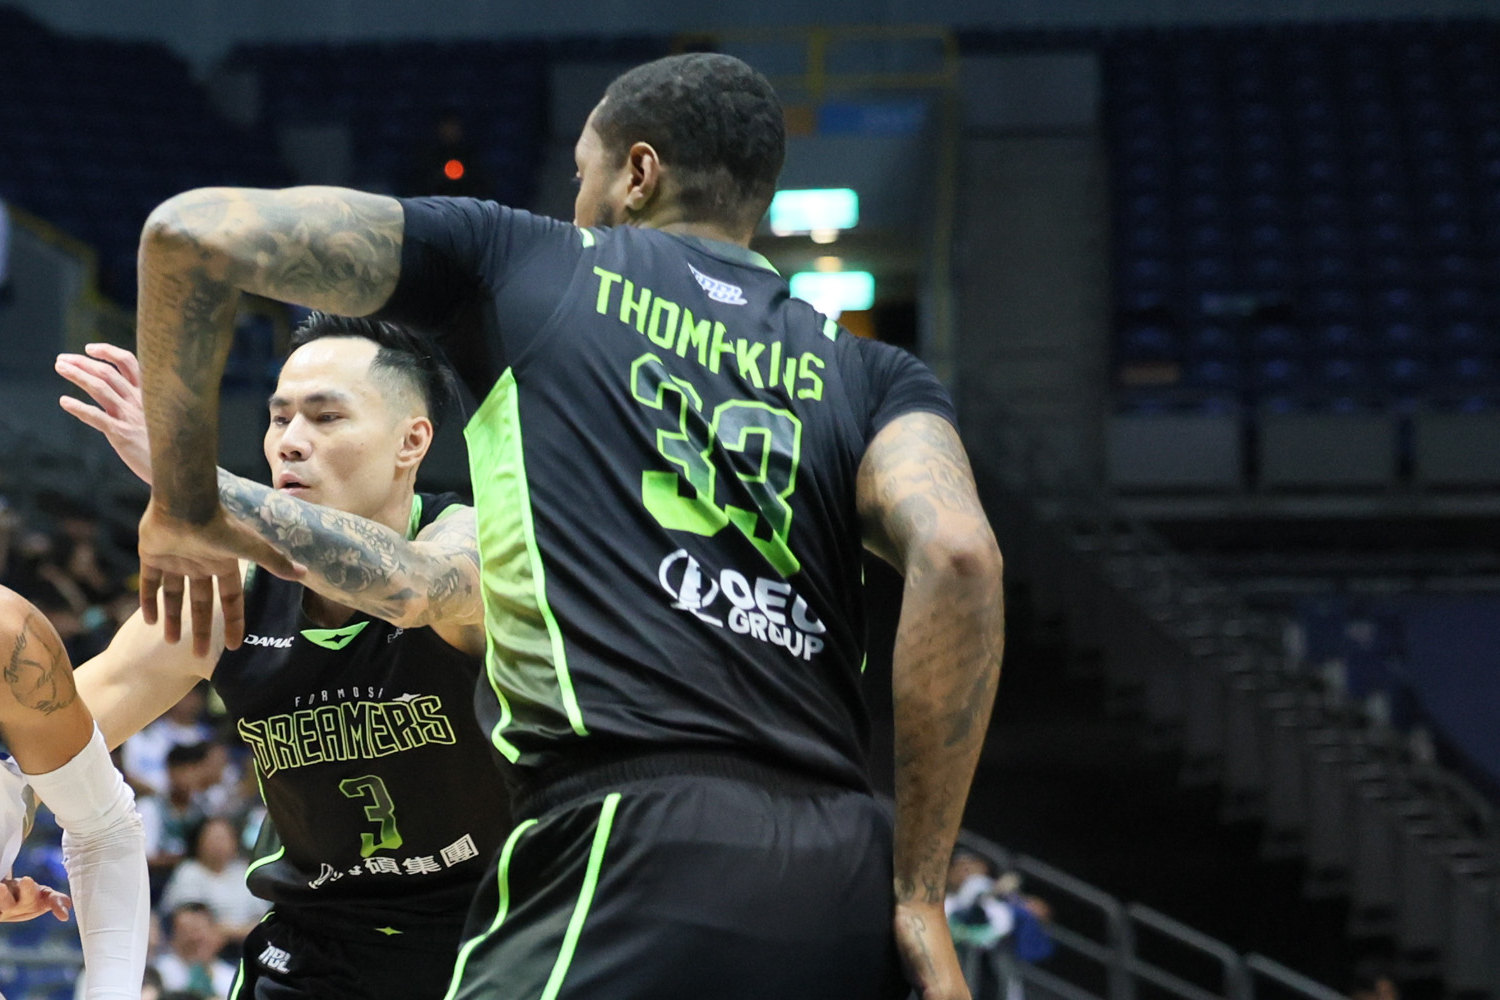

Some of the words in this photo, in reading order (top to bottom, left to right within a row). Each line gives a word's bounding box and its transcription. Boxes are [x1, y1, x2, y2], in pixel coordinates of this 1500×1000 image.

[728, 605, 825, 662] GROUP
[237, 695, 457, 779] DREAMERS
[339, 774, 403, 858] 3
